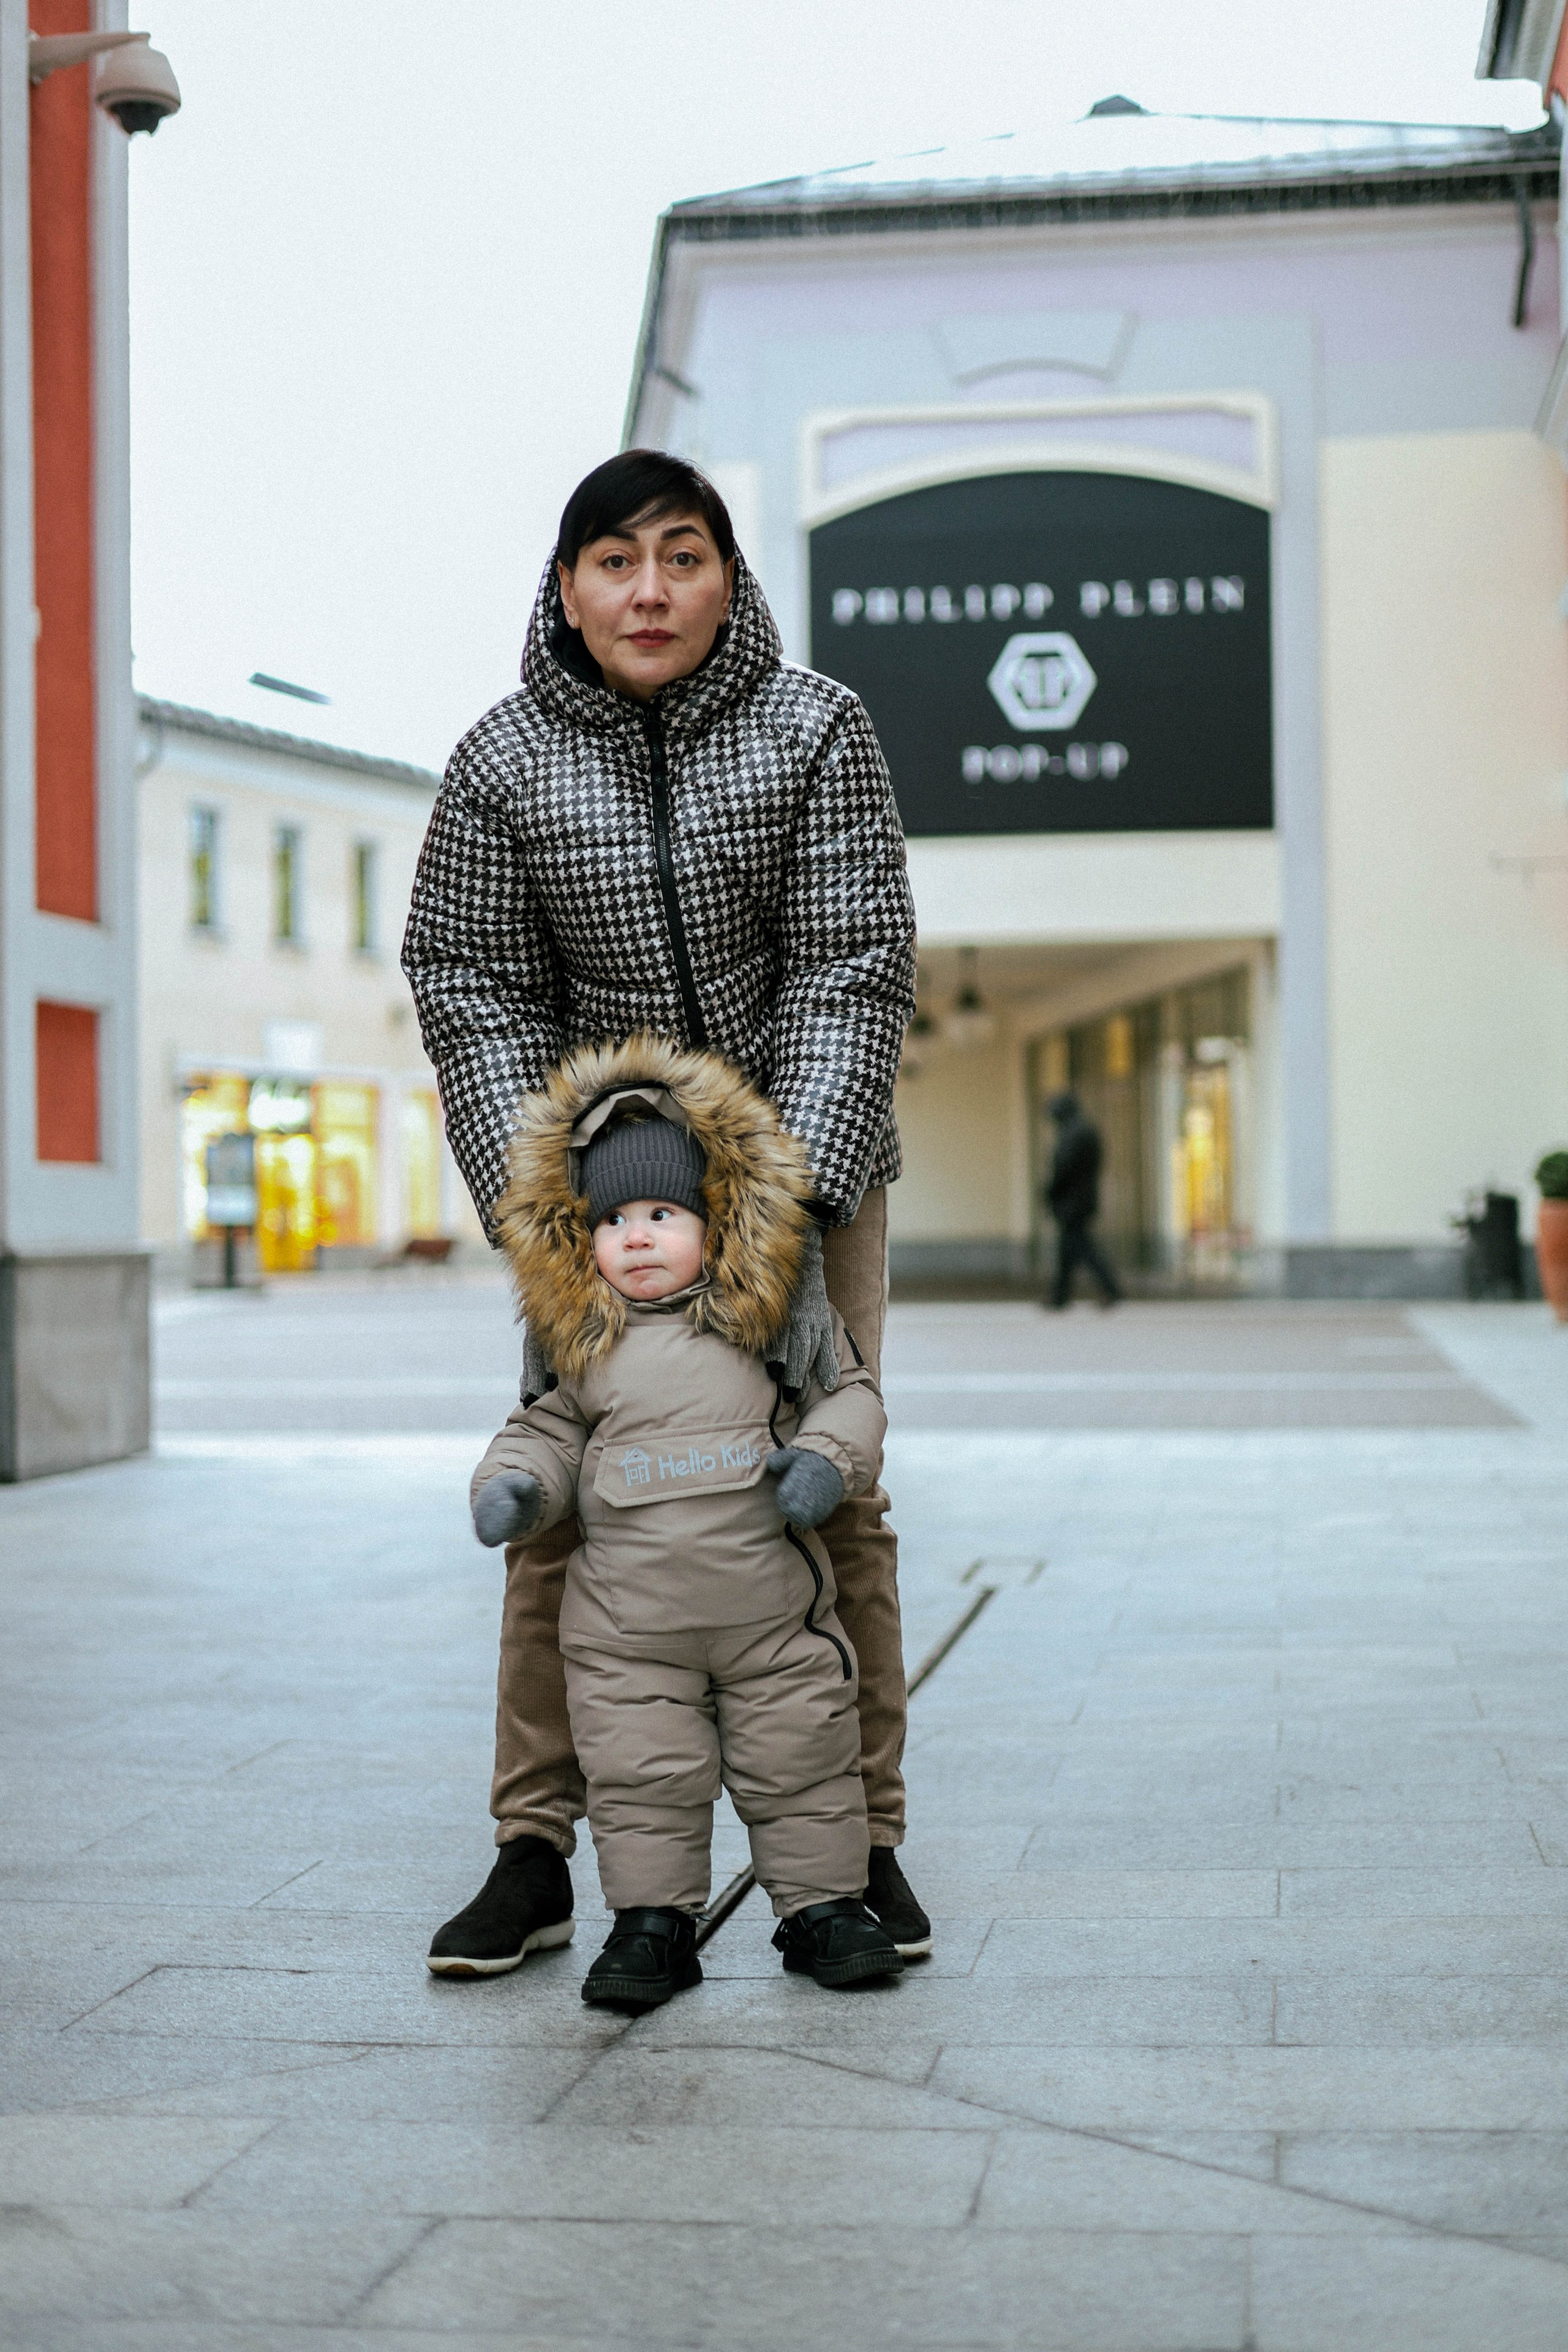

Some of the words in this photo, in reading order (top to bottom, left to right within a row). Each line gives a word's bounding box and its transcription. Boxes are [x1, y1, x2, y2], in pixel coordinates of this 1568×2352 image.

[832, 583, 1054, 625] PHILIPP
[1080, 576, 1245, 619] PLEIN
[658, 1447, 716, 1479] Hello
[720, 1442, 761, 1469] Kids
